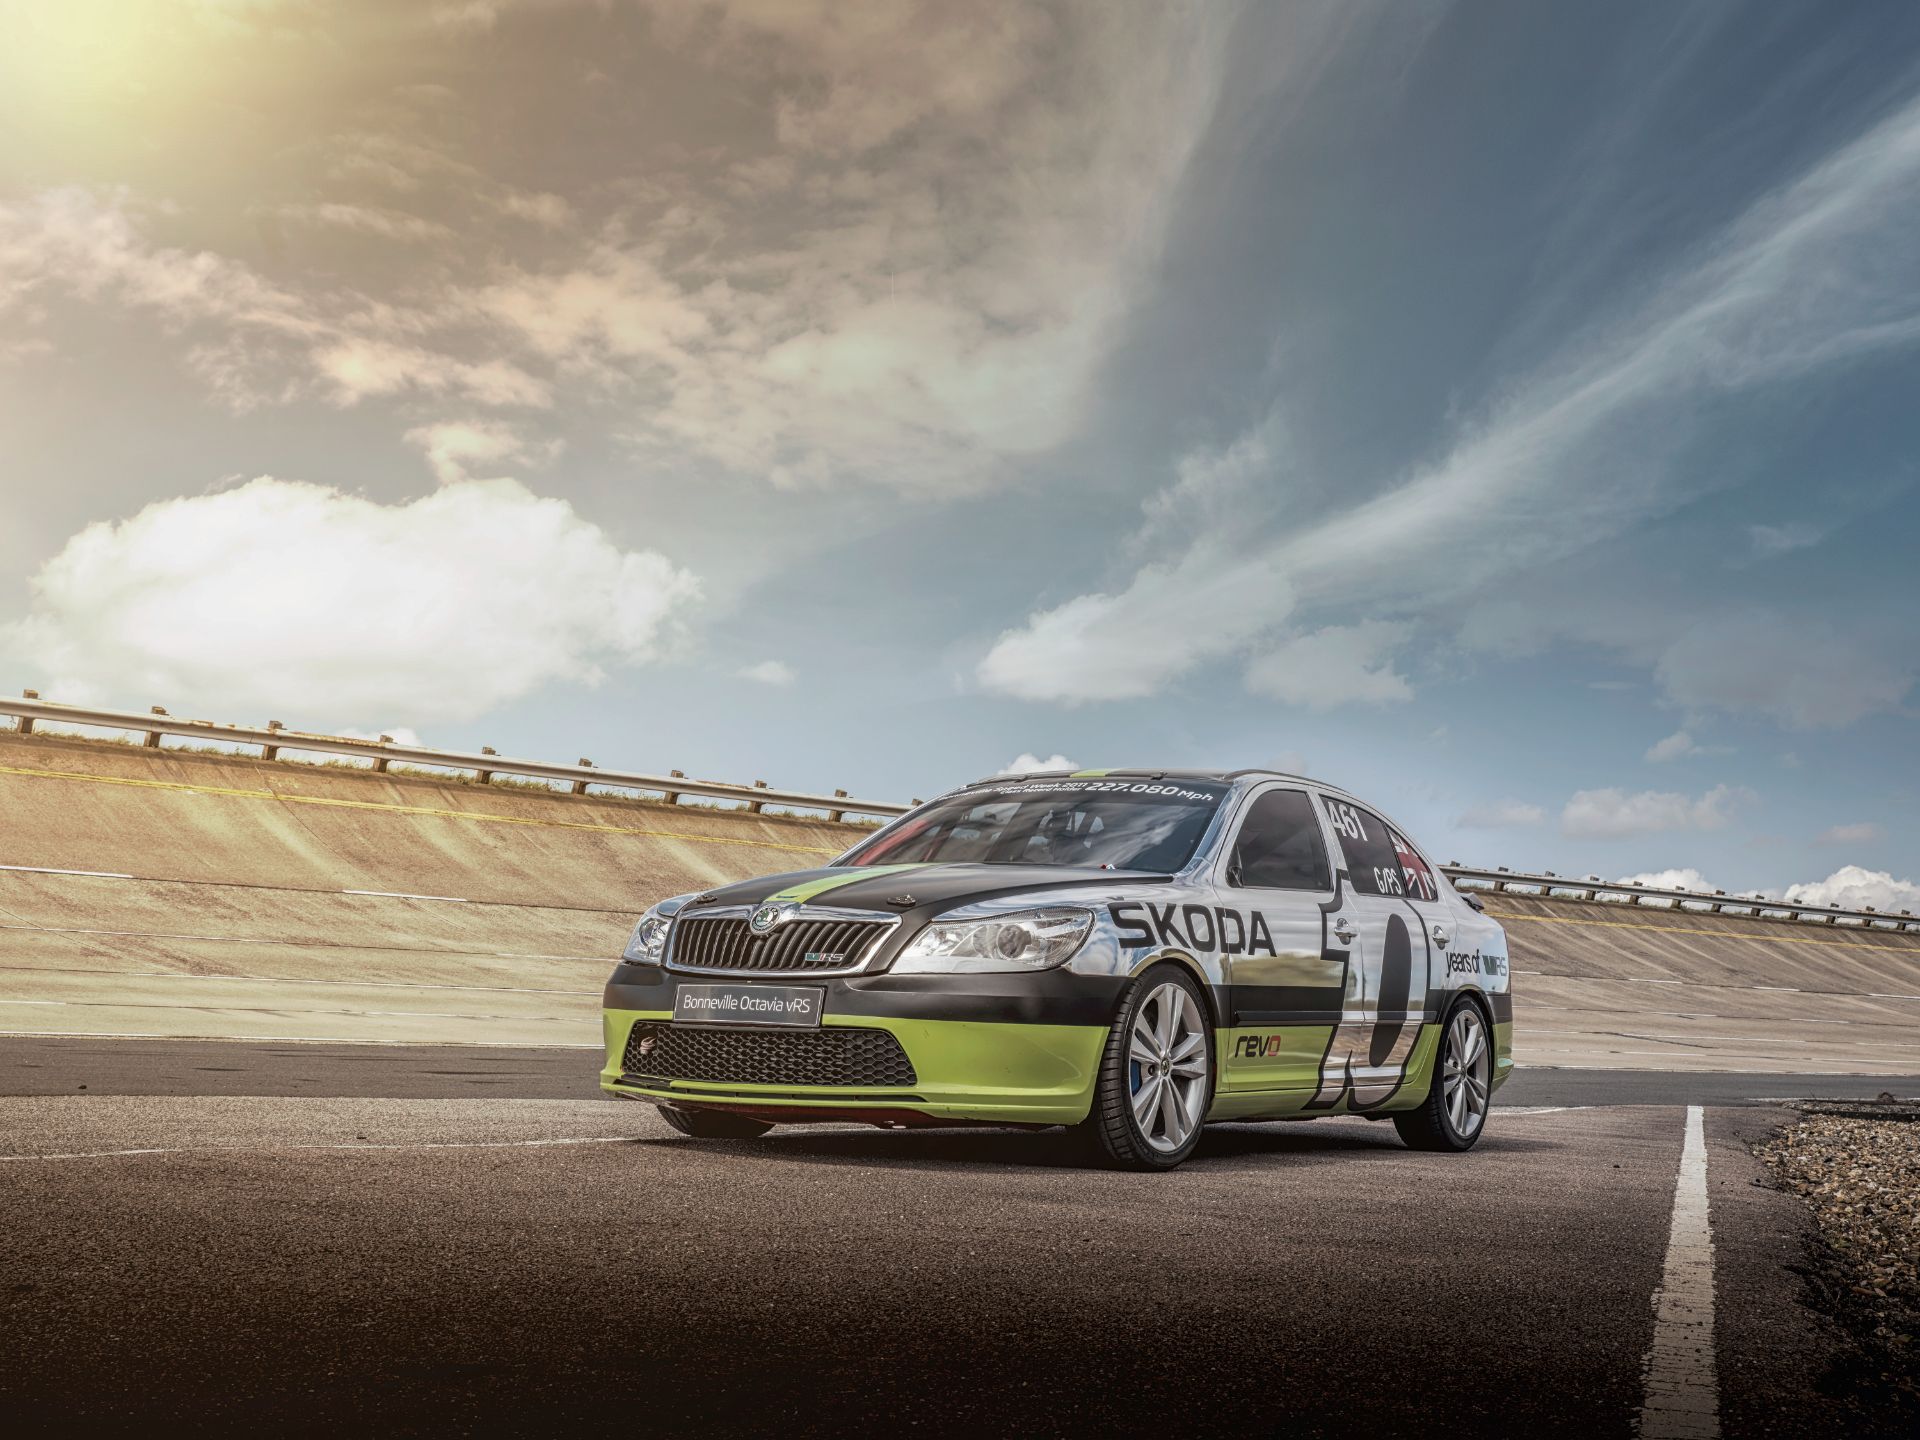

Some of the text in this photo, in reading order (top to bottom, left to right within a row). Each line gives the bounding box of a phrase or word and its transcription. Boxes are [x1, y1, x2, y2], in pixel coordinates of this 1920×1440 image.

[1085, 782, 1214, 801] 227.080 Mph
[1328, 801, 1368, 842] 461
[1446, 951, 1472, 978] years
[1472, 948, 1480, 975] of
[683, 994, 810, 1013] Bonneville Octavia vRS
